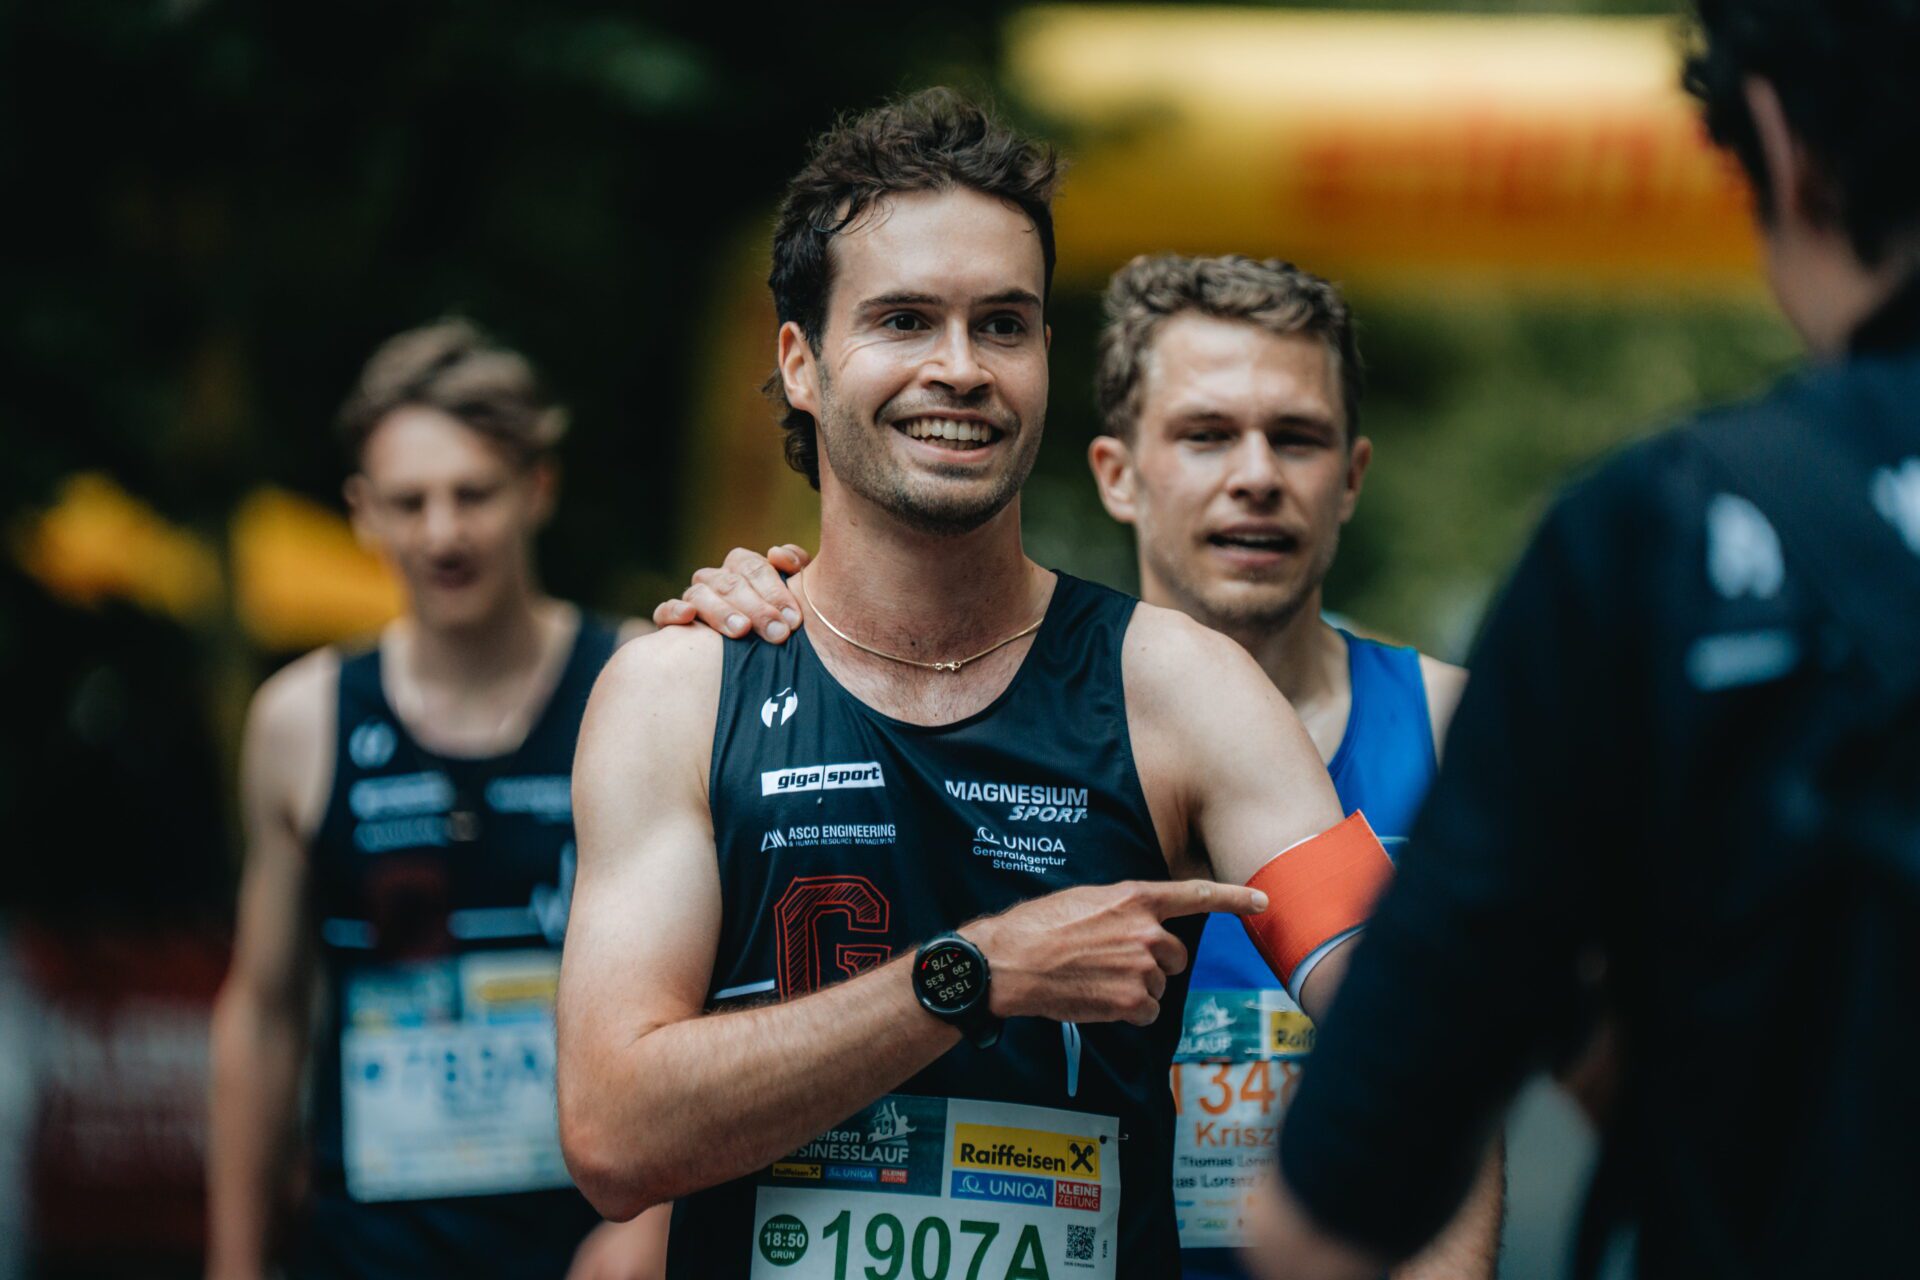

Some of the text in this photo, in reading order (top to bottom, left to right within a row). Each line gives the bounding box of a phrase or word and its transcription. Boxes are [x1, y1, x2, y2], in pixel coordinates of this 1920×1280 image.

[777, 767, 880, 789] giga sport
[944, 780, 1089, 806] MAGNESIUM
[788, 824, 897, 840] ASCO ENGINEERING
[795, 839, 819, 847] HUMAN
[1003, 836, 1067, 853] UNIQA
[972, 846, 1067, 867] GeneralAgentur
[992, 860, 1047, 875] Stenitzer
[931, 953, 954, 970] 178
[939, 979, 972, 1002] 15:55
[960, 1143, 1067, 1173] Raiffeisen
[843, 1166, 874, 1179] UNIQA
[989, 1180, 1048, 1200] UNIQA
[1058, 1182, 1099, 1198] KLEINE
[1057, 1194, 1098, 1210] ZEITUNG
[768, 1222, 801, 1231] STARTZEIT
[764, 1232, 806, 1248] 18:50
[822, 1210, 1051, 1280] 1907A
[771, 1249, 795, 1260] GRÜN
